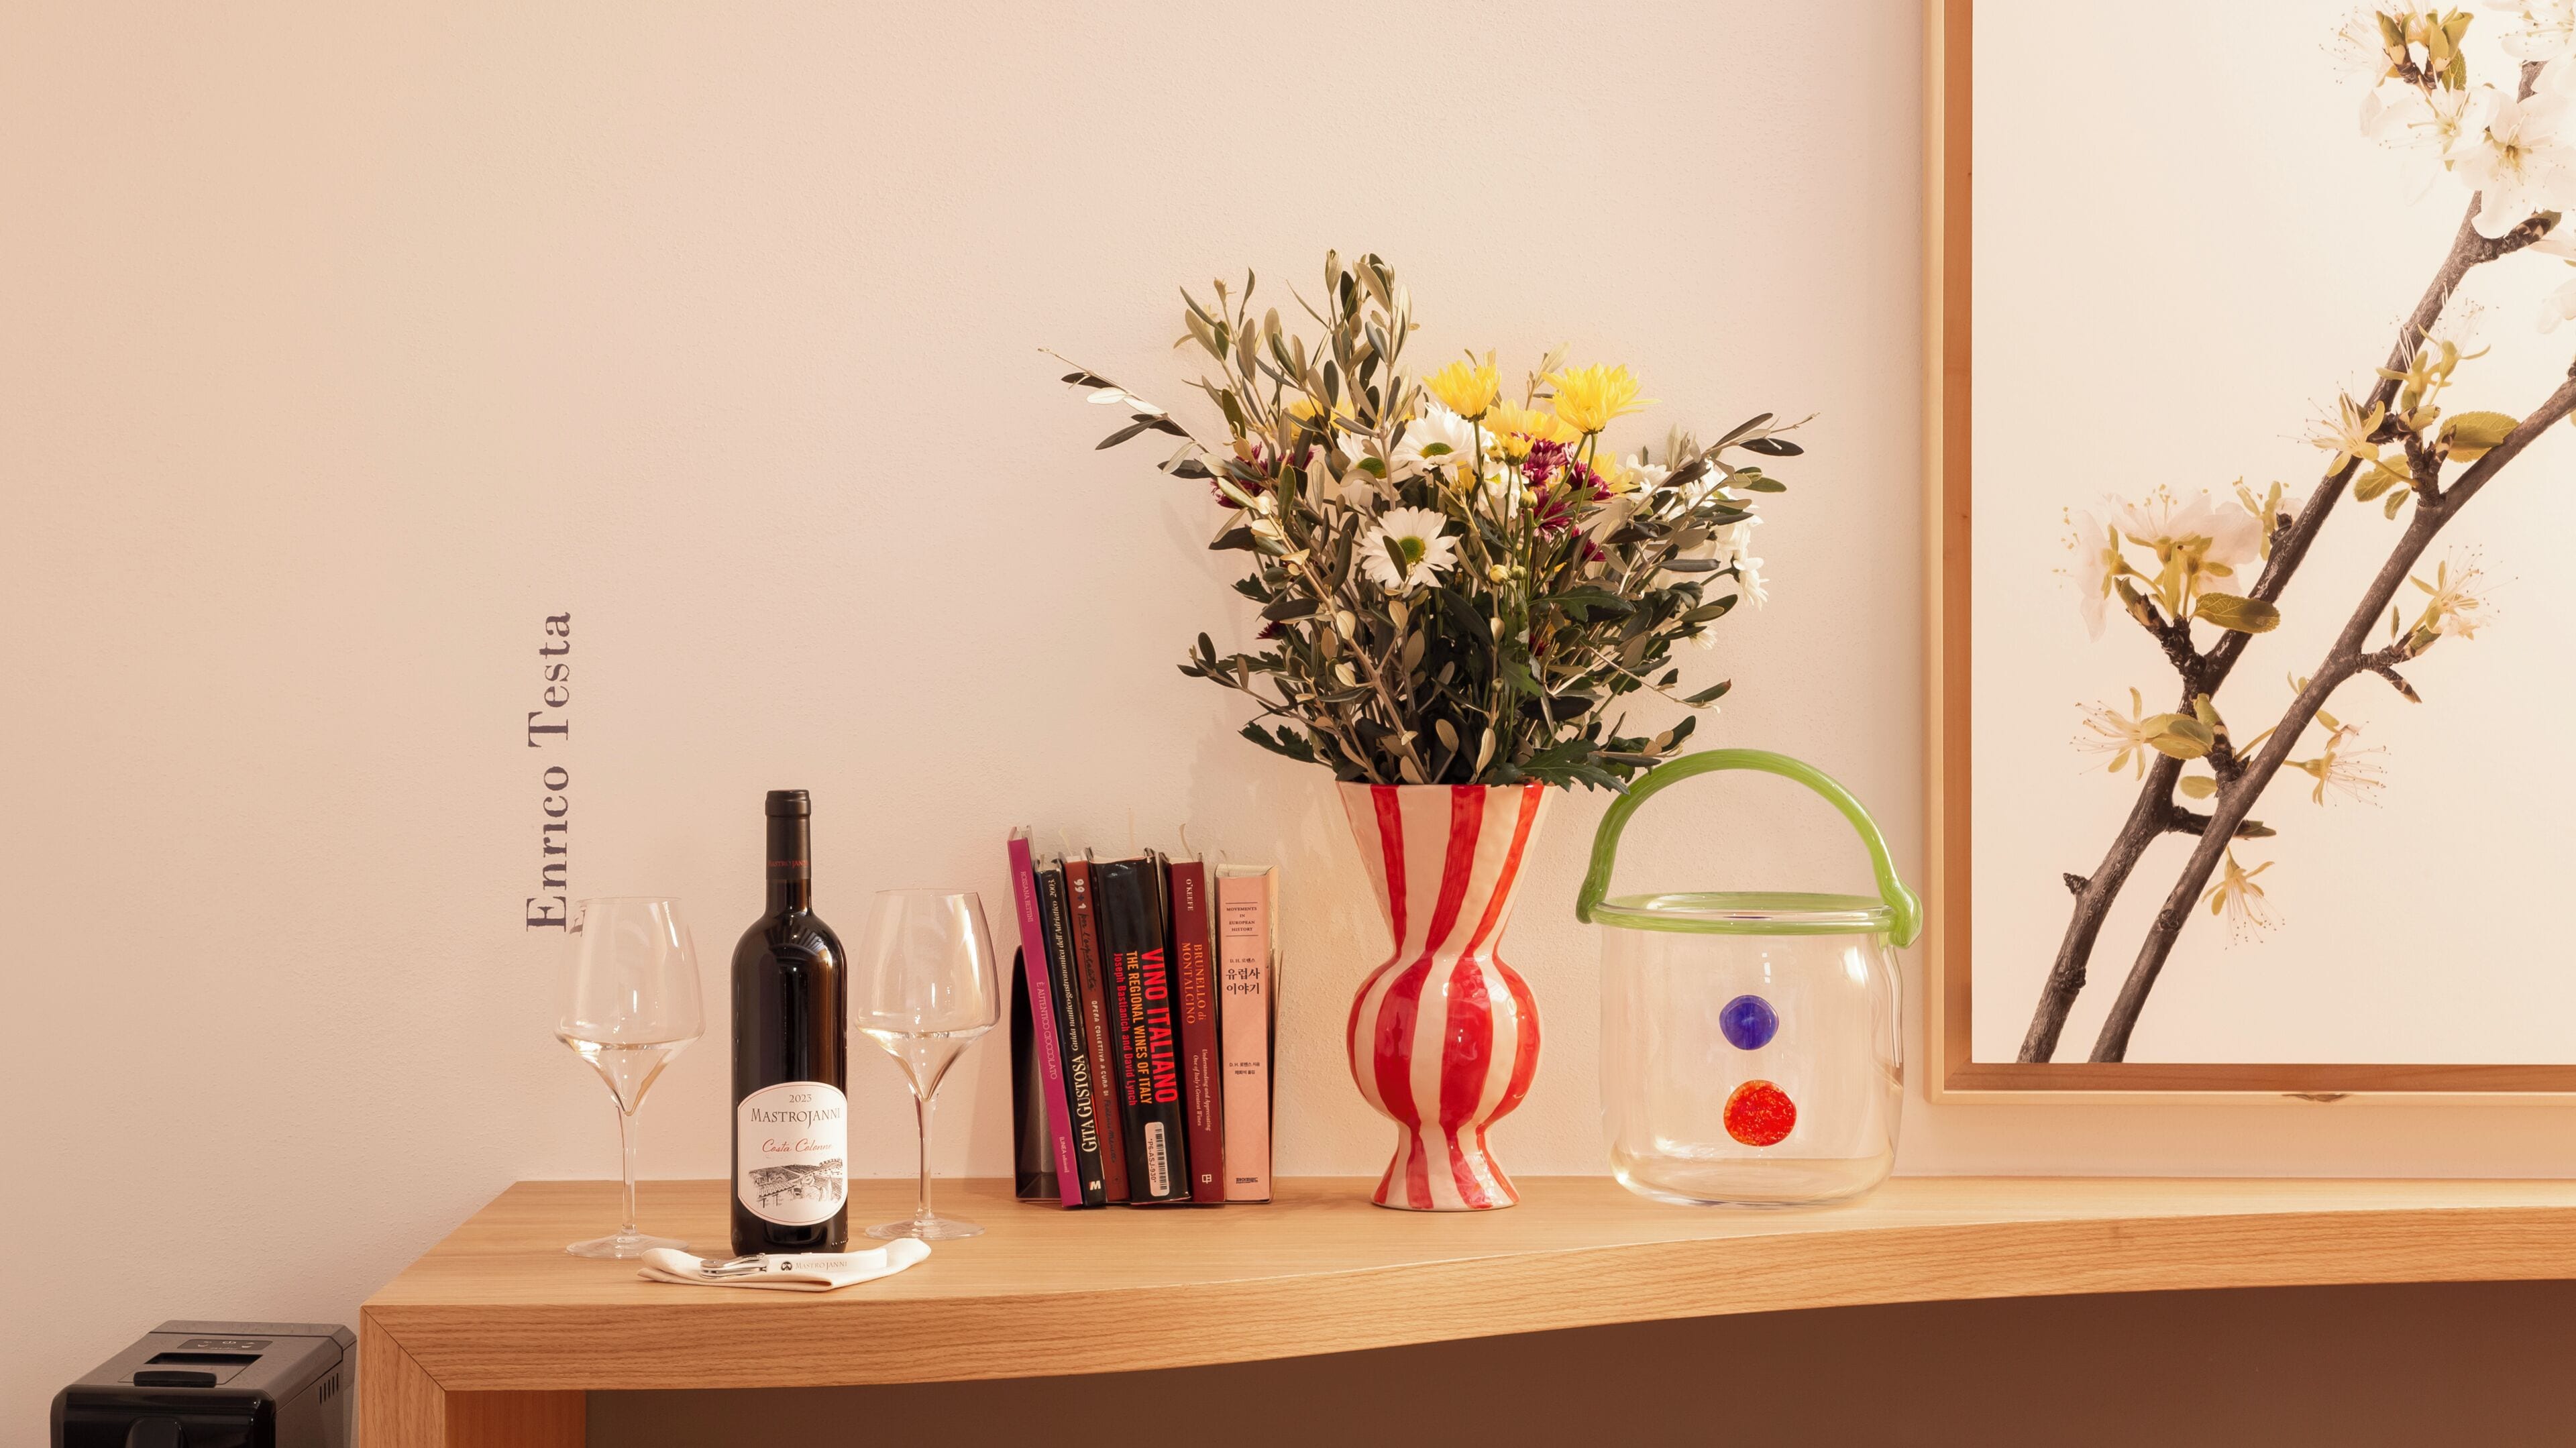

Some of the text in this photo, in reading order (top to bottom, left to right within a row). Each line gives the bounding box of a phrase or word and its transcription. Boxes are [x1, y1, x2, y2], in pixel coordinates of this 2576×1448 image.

[527, 612, 571, 932] Enrico Testa
[1185, 879, 1194, 911] O'KEEFE
[1181, 942, 1195, 1024] MONTALCINO
[1193, 944, 1207, 1020] BRUNELLO di
[1226, 968, 1260, 980] 유럽사
[1226, 983, 1260, 995] 이야기
[1091, 1001, 1100, 1022] OPERA
[1126, 950, 1152, 1104] THE REGIONAL WINES OF ITALY
[1141, 948, 1178, 1103] VINO ITALIANO
[1037, 989, 1050, 1030] AUTENTICO
[1044, 1031, 1057, 1080] CIOCCOLATO
[1069, 1028, 1079, 1051] Guida
[1095, 1025, 1105, 1062] COLLETTIVA
[1114, 953, 1137, 1106] Joseph Bastianich and David Lynch
[789, 1094, 812, 1103] 2023
[1072, 1054, 1097, 1152] GITA GUSTOSA
[1203, 1099, 1212, 1131] Appreciating
[751, 1108, 840, 1129] MASTROJANNI
[762, 1138, 792, 1152] Costa
